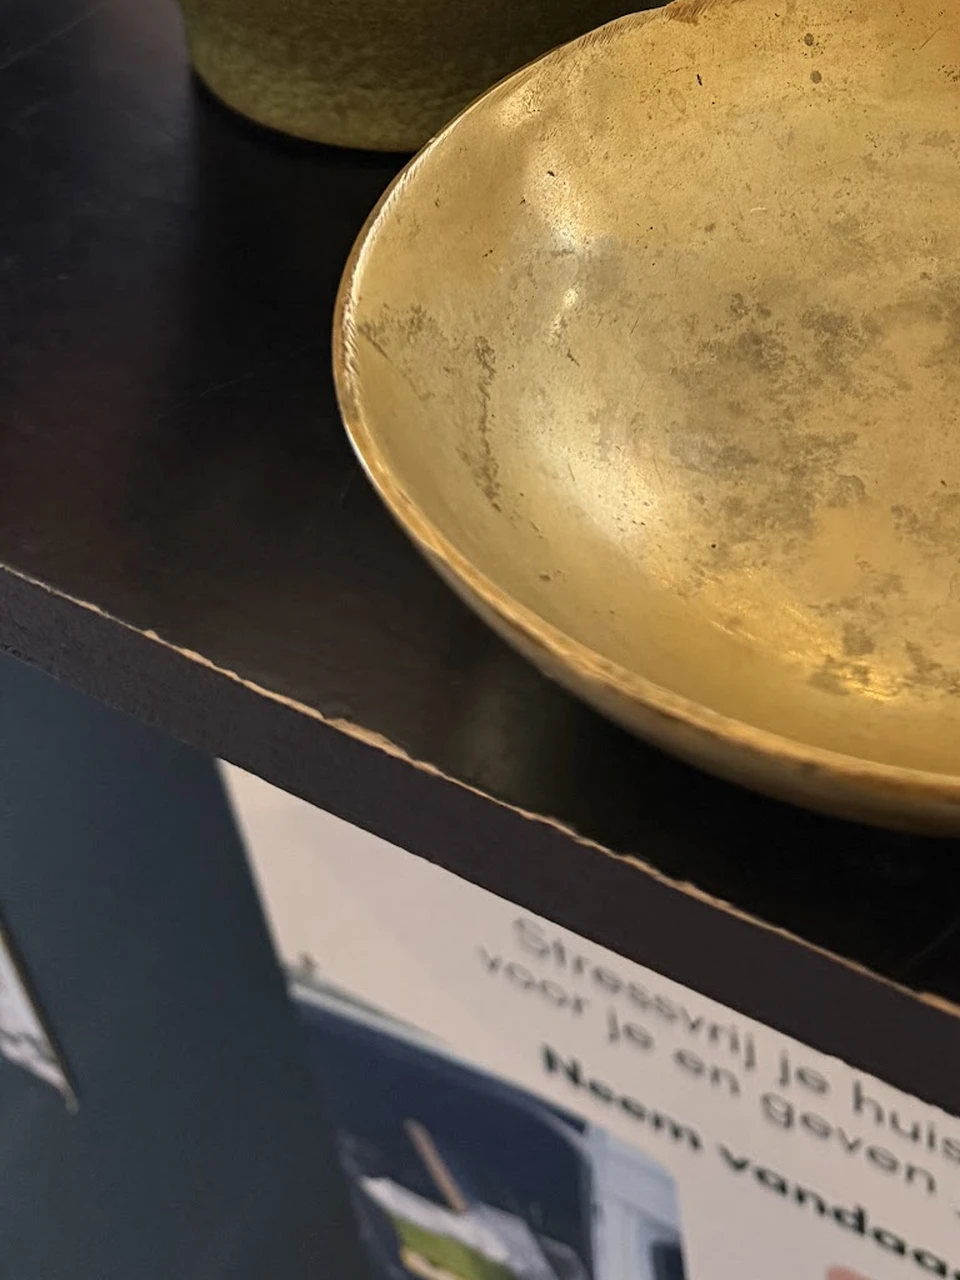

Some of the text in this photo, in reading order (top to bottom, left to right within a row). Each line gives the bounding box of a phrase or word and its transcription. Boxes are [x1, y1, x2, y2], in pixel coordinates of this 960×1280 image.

[475, 943, 588, 1015] voor
[605, 1004, 653, 1050] je
[673, 1049, 741, 1098] en
[760, 1091, 937, 1196] geven
[513, 917, 756, 1069] Stressvrij
[778, 1047, 830, 1095] je
[541, 1041, 703, 1152] Neem
